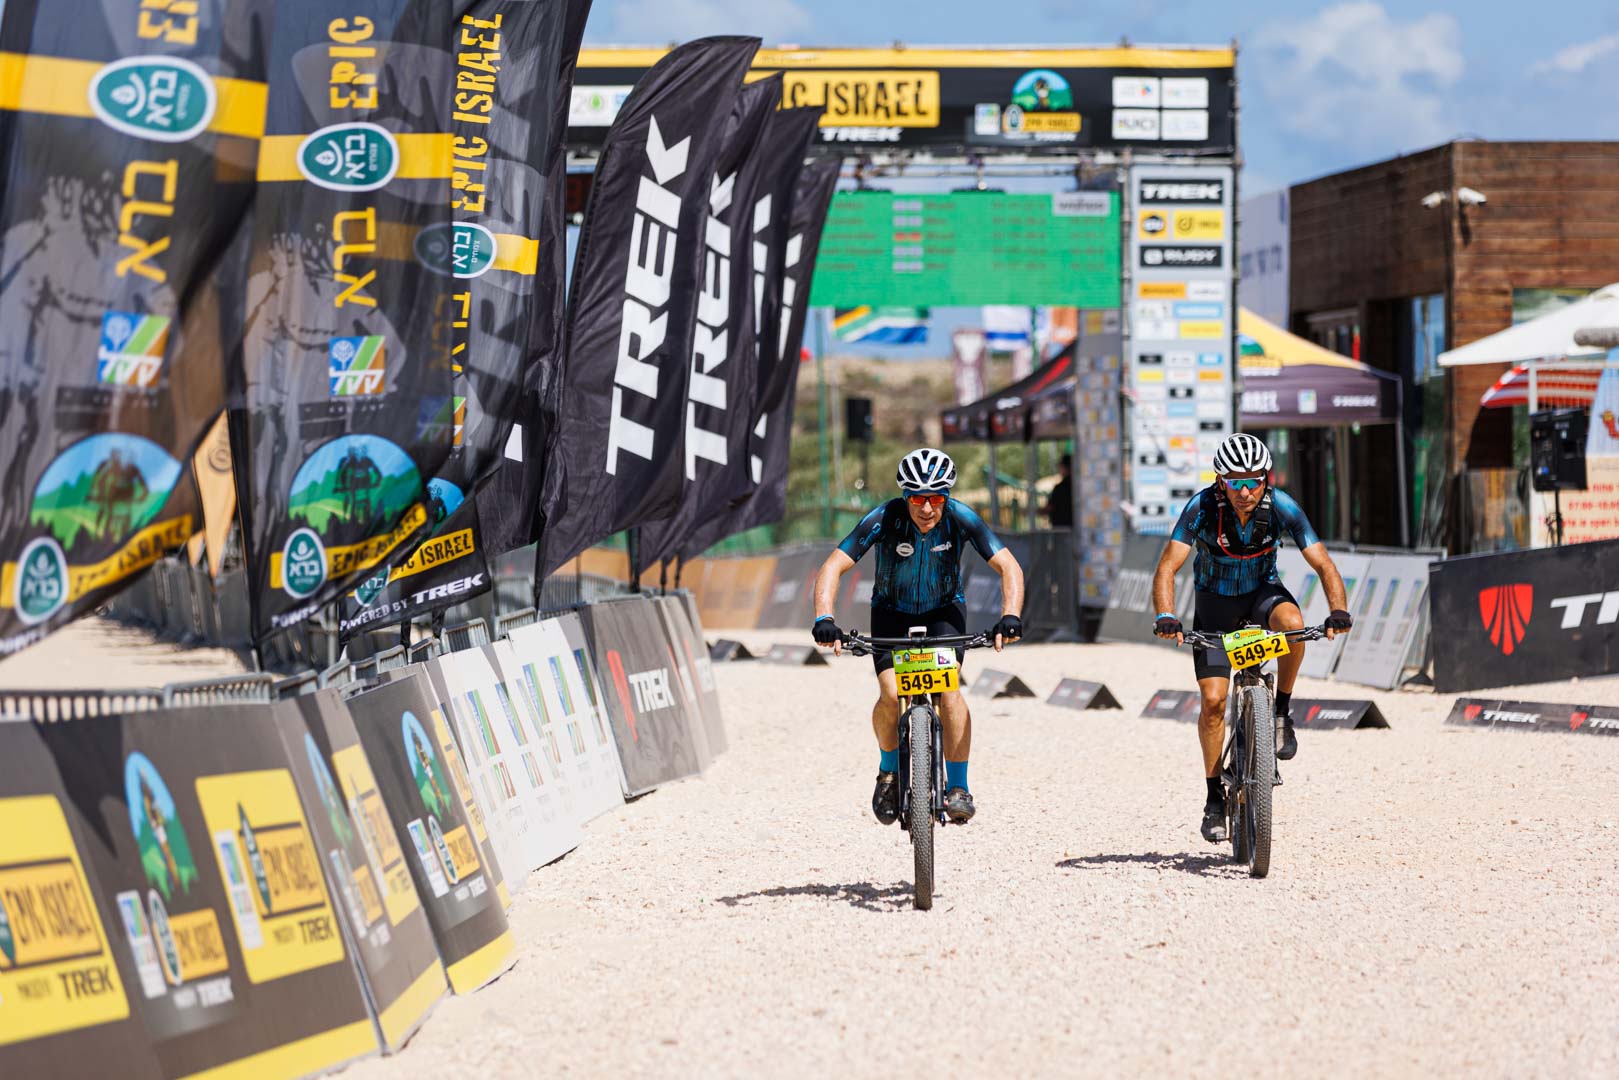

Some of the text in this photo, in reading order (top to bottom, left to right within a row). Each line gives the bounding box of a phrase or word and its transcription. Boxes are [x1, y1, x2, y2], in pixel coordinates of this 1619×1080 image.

[327, 15, 378, 109] EPIC
[145, 70, 179, 127] ברא
[451, 13, 504, 213] EPIC ISRAEL
[345, 134, 367, 180] ברא
[1142, 184, 1222, 200] TREK
[116, 159, 179, 282] ברא
[334, 207, 378, 308] ברא
[605, 114, 692, 475] TREK
[684, 171, 738, 481] TREK
[419, 533, 472, 566] ISRAEL
[392, 597, 409, 612] BY
[411, 571, 484, 605] TREK
[1233, 637, 1284, 666] 549-2
[628, 667, 676, 714] TREK
[900, 671, 950, 692] 549-1
[1317, 709, 1354, 720] TREK
[1482, 709, 1542, 724] TREK
[298, 915, 336, 946] TREK
[57, 964, 116, 1001] TREK
